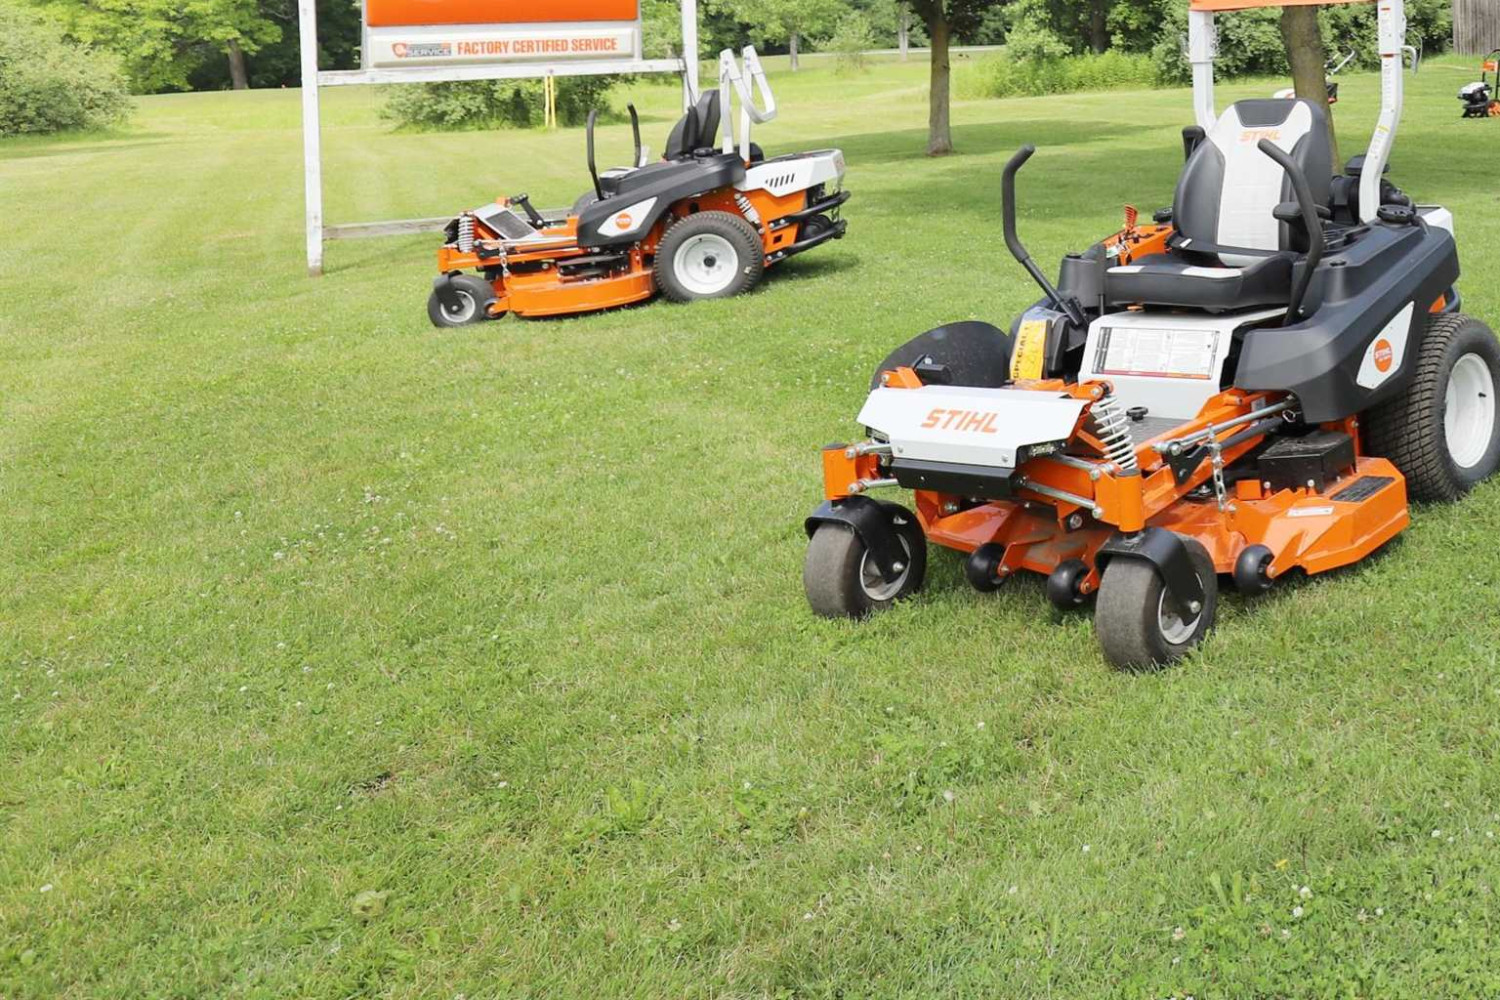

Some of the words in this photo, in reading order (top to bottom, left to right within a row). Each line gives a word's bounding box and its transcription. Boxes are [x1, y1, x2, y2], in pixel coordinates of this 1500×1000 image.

[457, 40, 509, 55] FACTORY
[513, 39, 568, 53] CERTIFIED
[571, 37, 618, 52] SERVICE
[920, 407, 999, 433] STIHL
